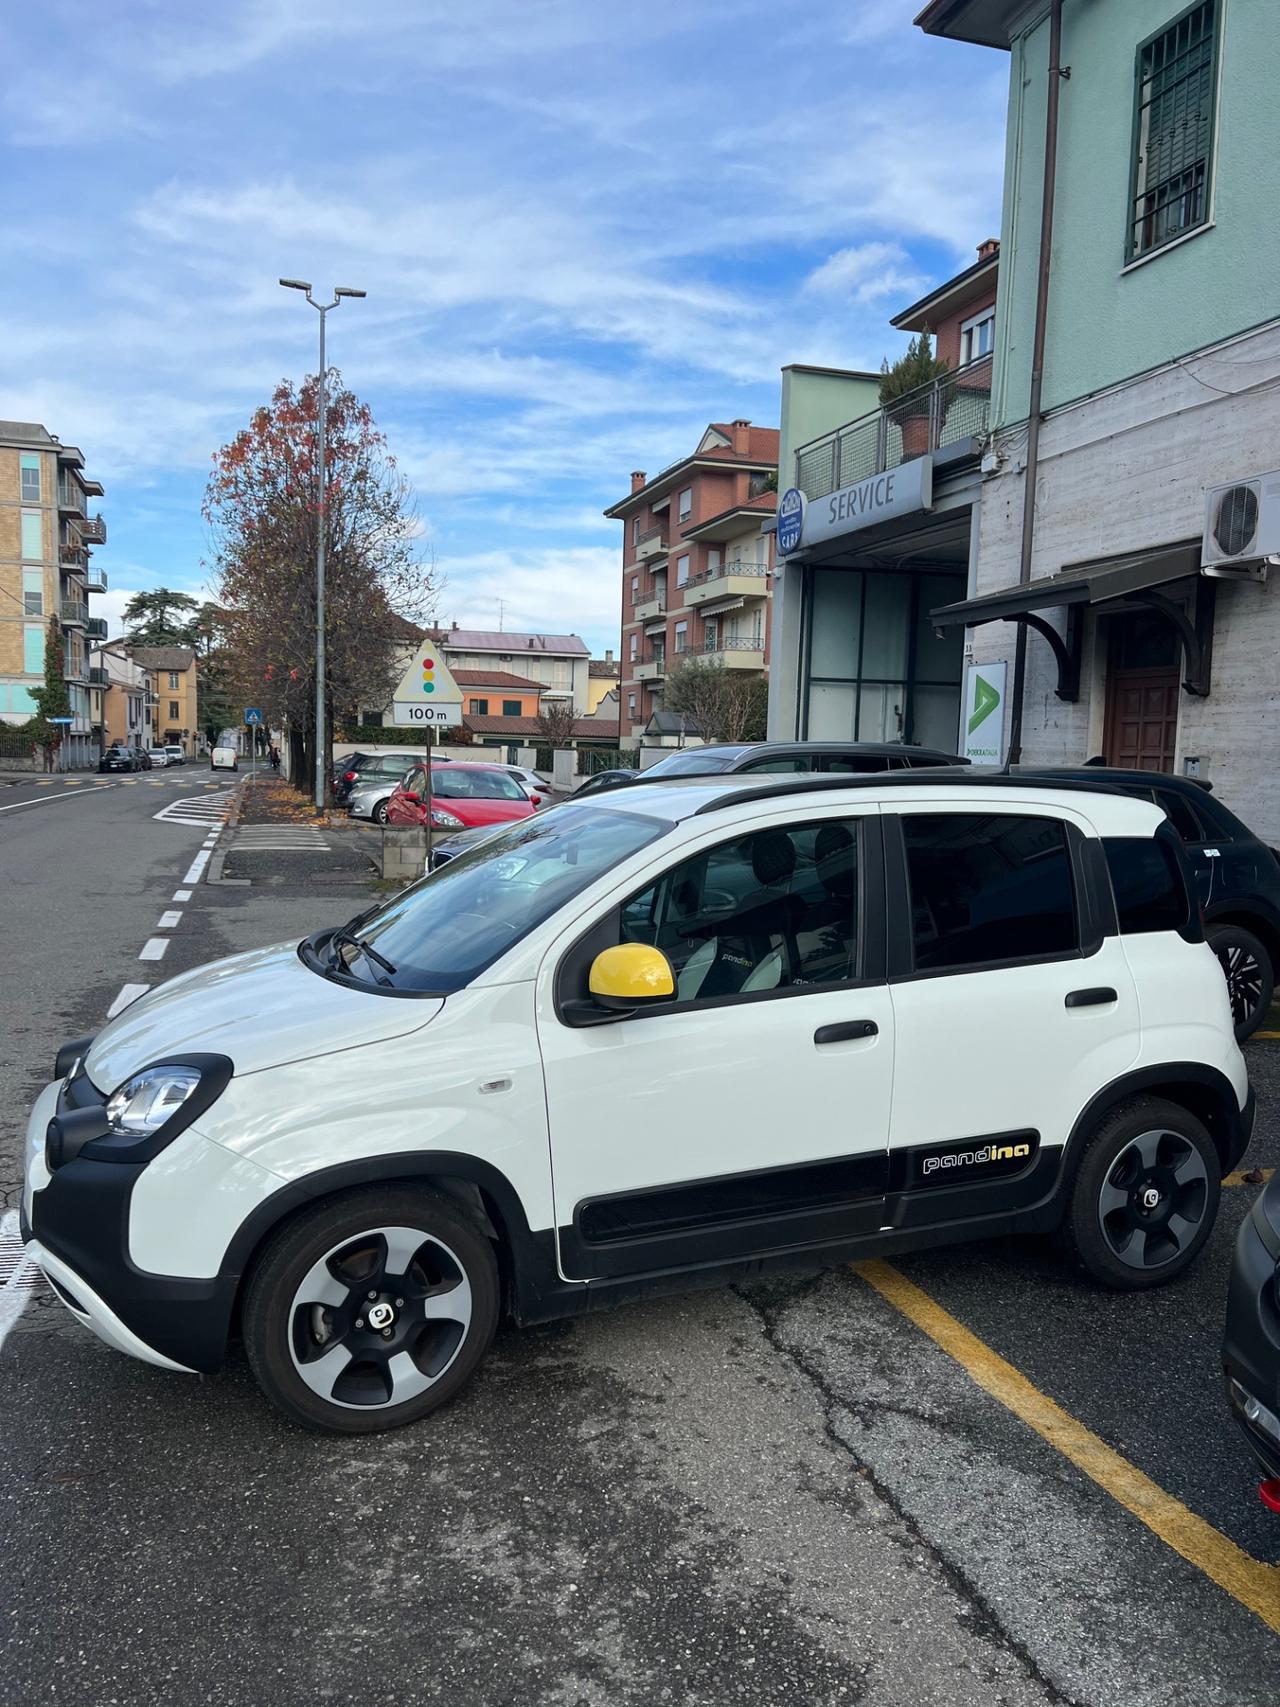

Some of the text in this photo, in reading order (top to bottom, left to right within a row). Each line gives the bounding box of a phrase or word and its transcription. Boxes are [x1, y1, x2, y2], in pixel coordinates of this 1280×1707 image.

[828, 474, 896, 524] SERVICE
[781, 531, 798, 549] CARS
[408, 708, 447, 720] 100 m
[922, 1144, 1030, 1175] pandina
